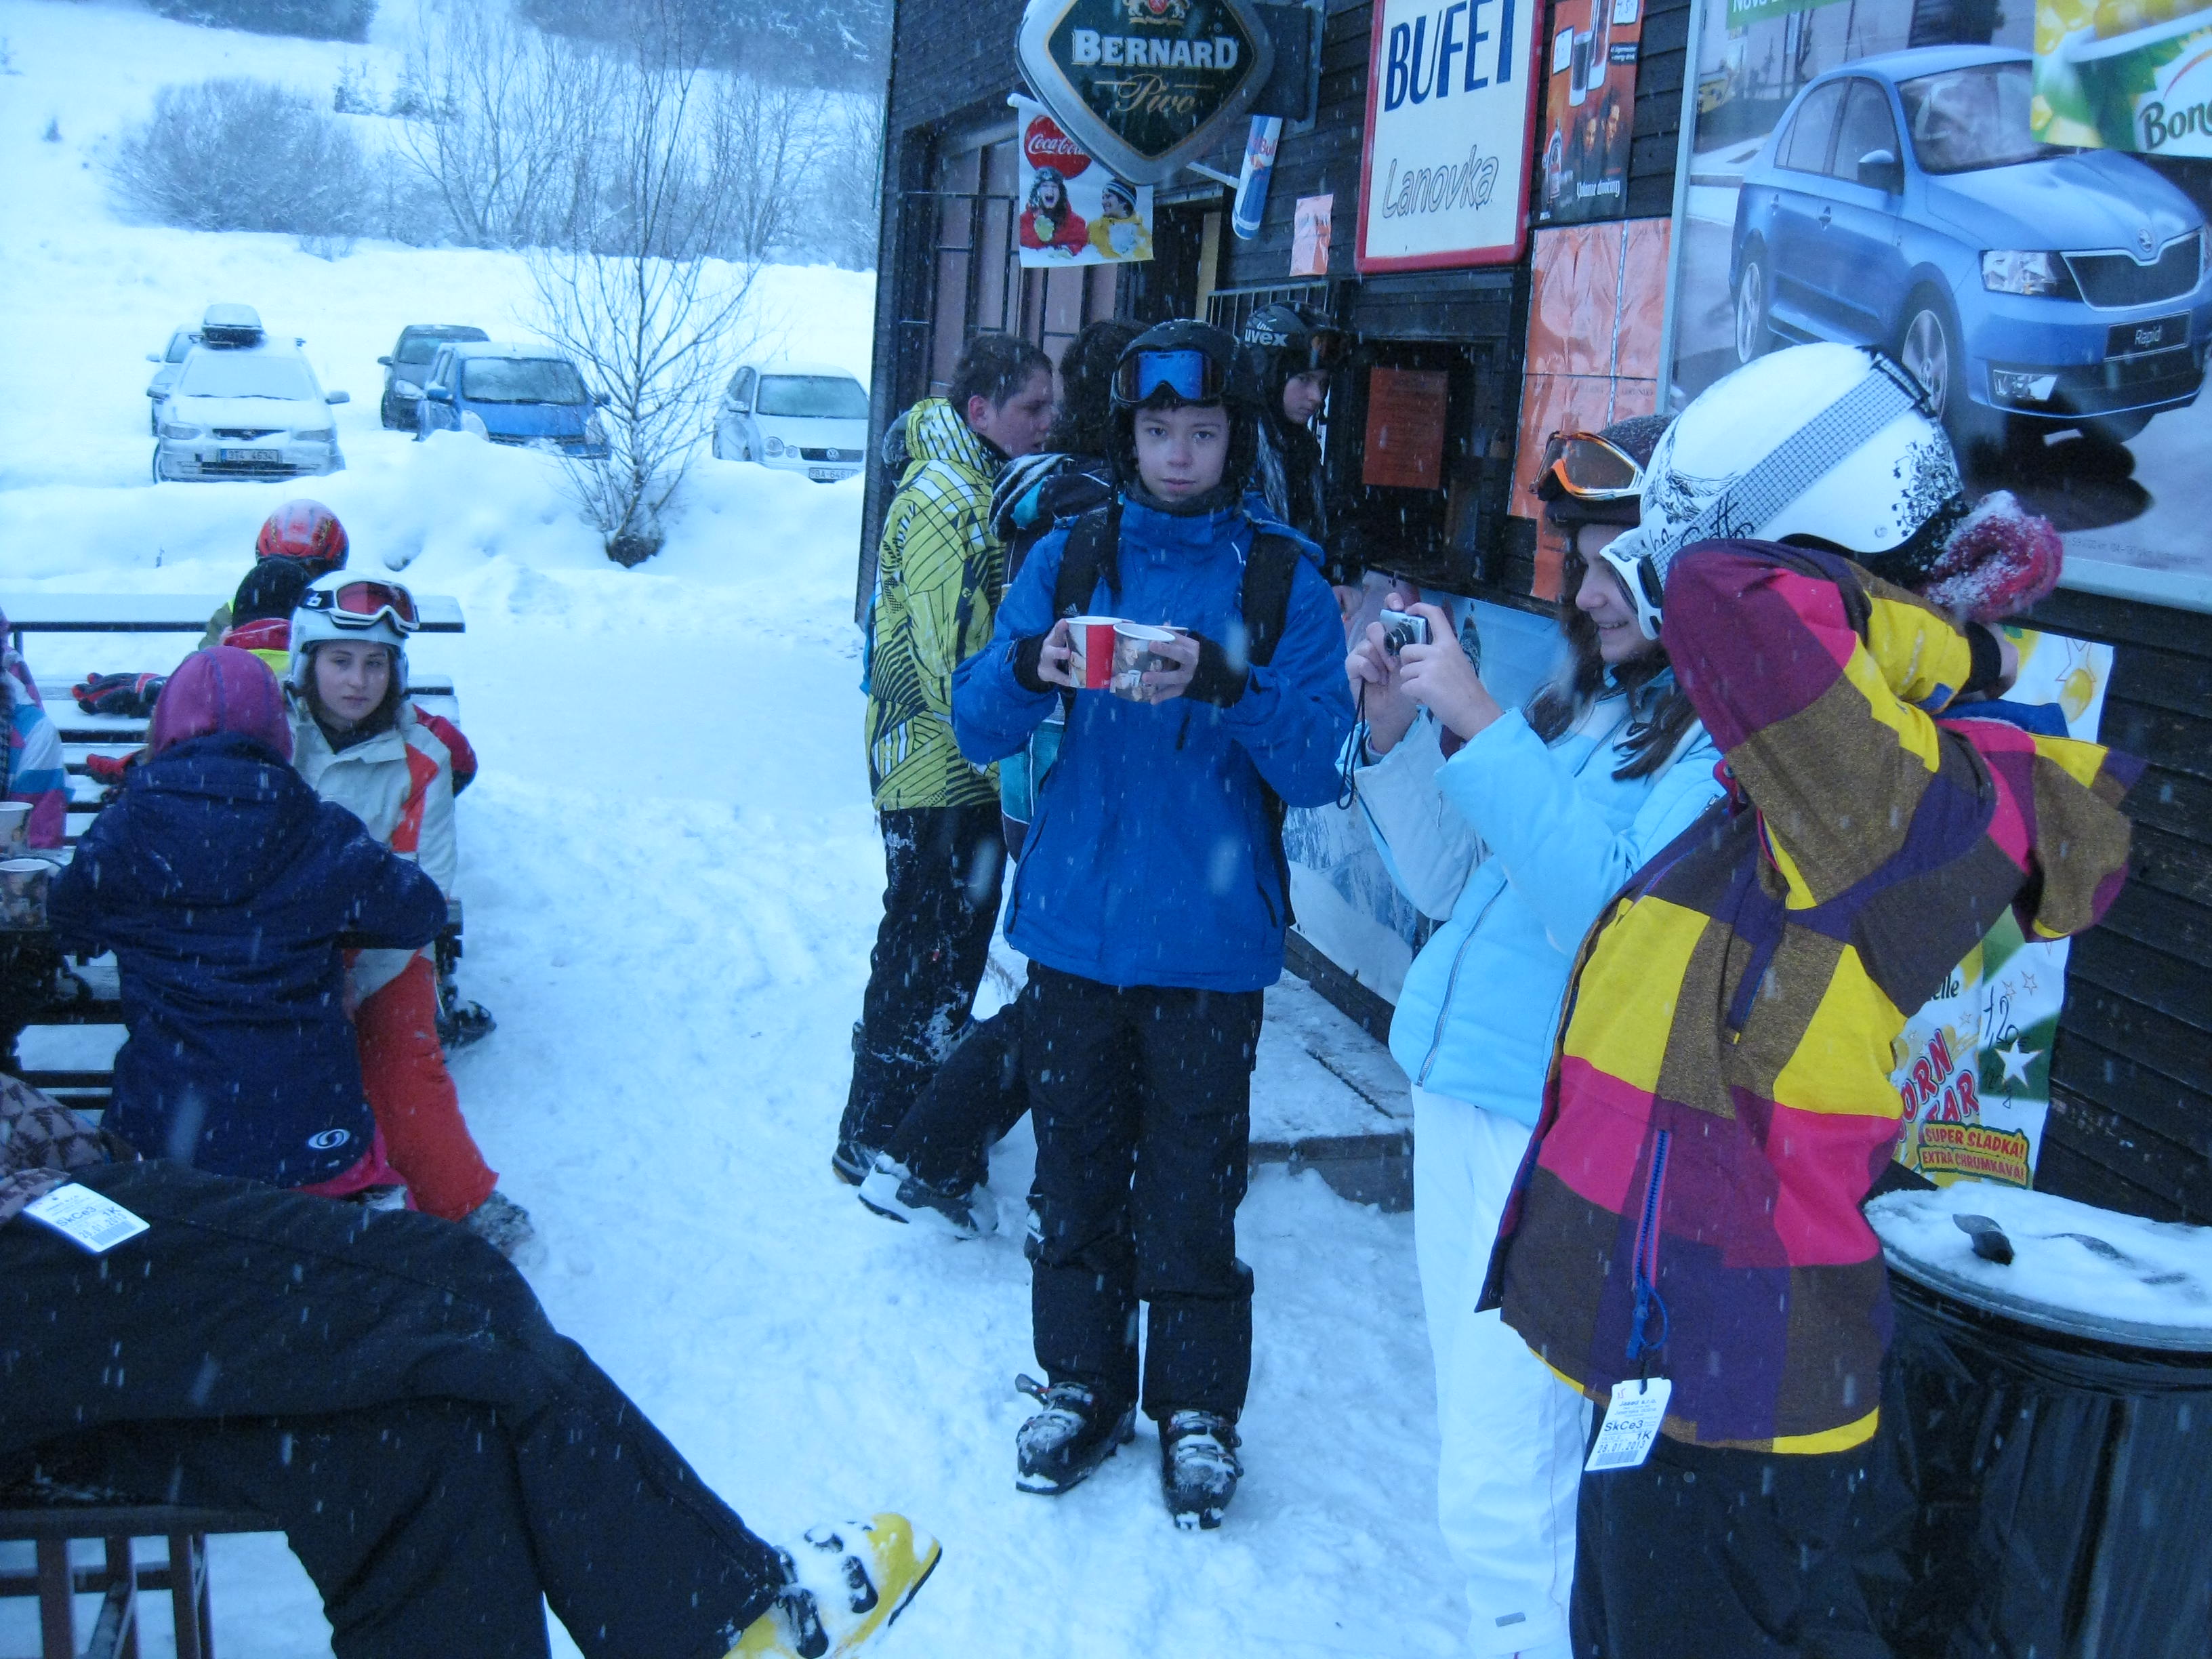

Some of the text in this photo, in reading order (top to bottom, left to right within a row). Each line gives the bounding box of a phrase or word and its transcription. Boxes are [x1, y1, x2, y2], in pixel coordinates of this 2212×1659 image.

[1071, 28, 1239, 70] BERNARD
[1382, 144, 1498, 219] Lanovka
[1245, 329, 1288, 347] uvex
[2135, 325, 2162, 348] Rapid
[1925, 1127, 1964, 1145] SUPER
[1923, 1151, 1954, 1164] EXTRA
[1604, 1420, 1643, 1431] SkCe3
